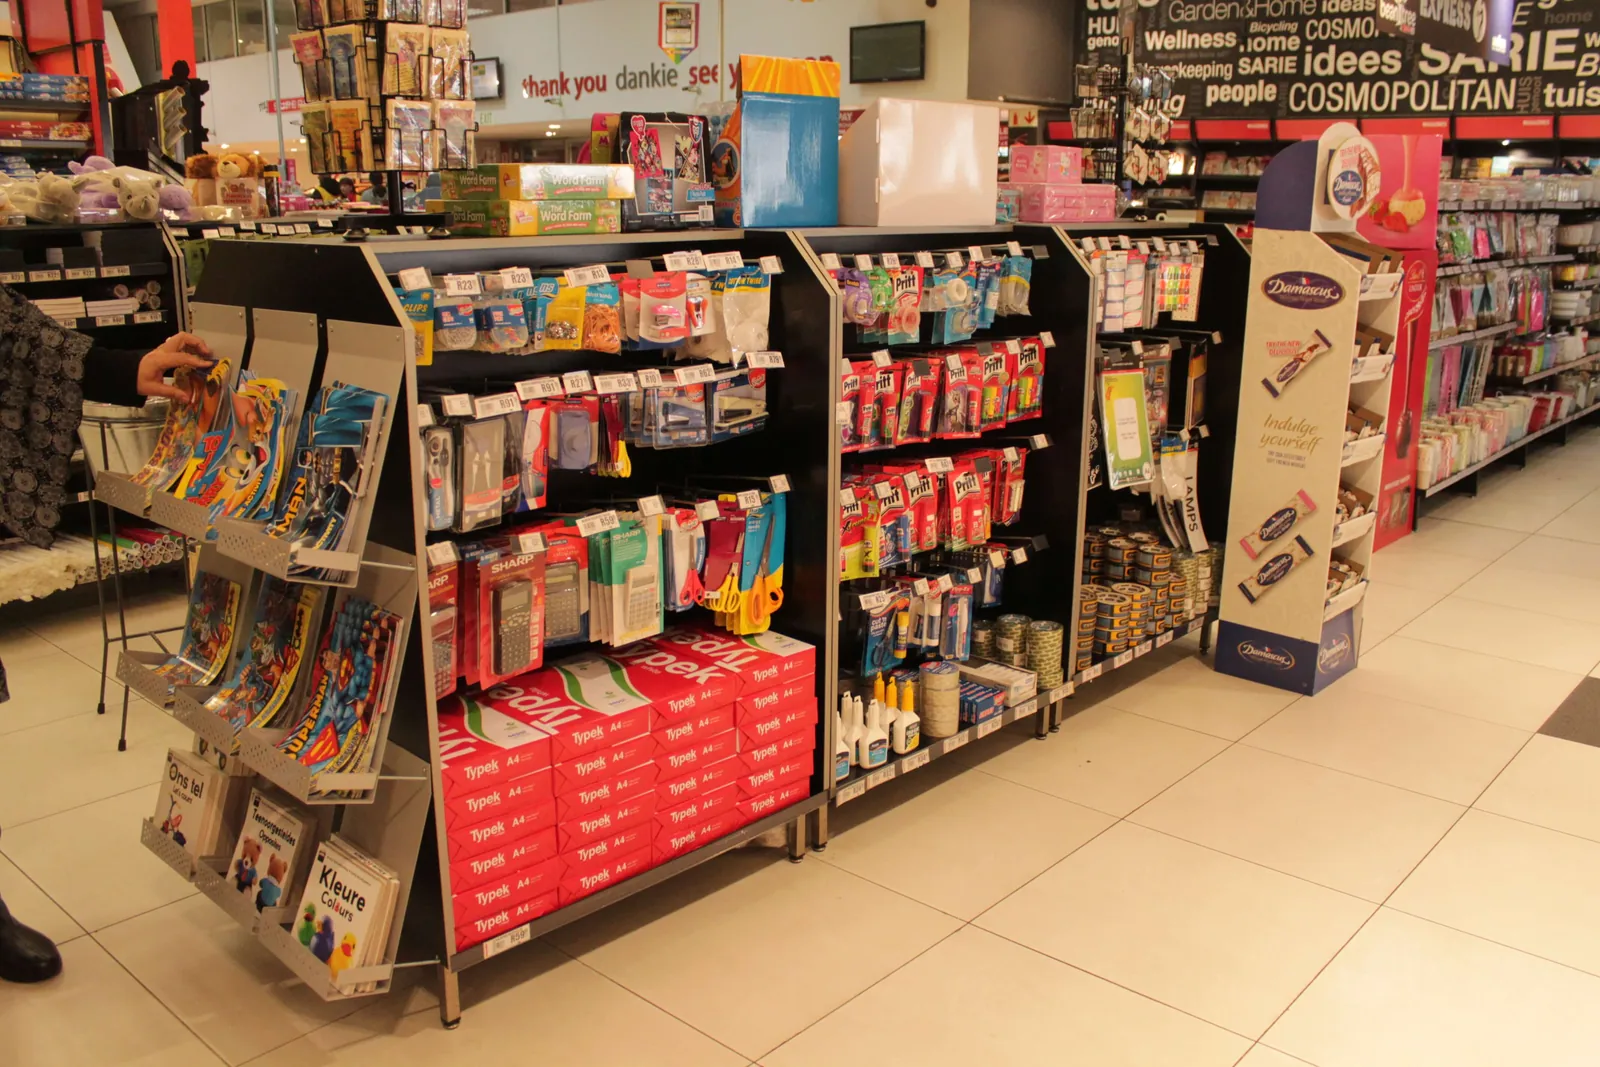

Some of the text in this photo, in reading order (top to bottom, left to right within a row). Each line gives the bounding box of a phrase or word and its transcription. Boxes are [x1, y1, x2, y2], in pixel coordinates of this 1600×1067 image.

[1250, 21, 1298, 34] Bicycling
[1305, 17, 1378, 40] COSMO
[1145, 29, 1237, 50] Wellness
[1238, 55, 1298, 75] SARIE
[1304, 44, 1402, 76] idees
[522, 71, 570, 97] thank
[574, 74, 607, 100] you
[615, 63, 678, 90] dankie
[1205, 79, 1277, 107] people
[1289, 78, 1516, 112] COSMOPOLITAN
[459, 173, 497, 185] Word Farm
[452, 211, 465, 221] ord
[541, 210, 592, 222] Word Farm
[896, 274, 916, 292] Pritt
[1267, 276, 1340, 300] Damascus
[403, 303, 428, 313] CLIPS
[984, 358, 1003, 374] Pritt
[1019, 349, 1037, 365] Pritt
[843, 378, 858, 391] Pritt
[875, 375, 892, 390] ritt
[950, 367, 965, 380] Pritt
[1263, 413, 1318, 438] Indulge
[1258, 433, 1324, 456] yourself
[956, 475, 976, 492] Pritt
[883, 489, 900, 507] ritt
[491, 554, 534, 574] SHARP
[428, 574, 449, 590] ARP
[1243, 643, 1291, 666] Damascus
[753, 662, 793, 682] Typek A4
[668, 690, 711, 713] Typek A4
[753, 688, 793, 710] Typek A4
[572, 721, 622, 746] Typek A4
[666, 718, 709, 741] Typek A4
[755, 713, 796, 735] Typek A4
[669, 745, 713, 768] Typek A4
[752, 739, 793, 761] Typek A4
[464, 754, 520, 780] Typek A4
[575, 751, 624, 777] Typek A4
[169, 763, 204, 799] Ons tel
[669, 772, 713, 796] Typek A4
[748, 765, 790, 787] Typek A4
[466, 787, 522, 812] Typek A4
[578, 780, 628, 804] Typek A4
[751, 790, 789, 813] Typek A4
[580, 809, 629, 834] Typek A4
[670, 799, 713, 823] Typek A4
[470, 815, 525, 843] Typek A4
[670, 825, 711, 849] Typek A4
[578, 836, 625, 861] Typek A4
[471, 847, 526, 874] Typek A4
[580, 863, 627, 889] Typek A4
[318, 865, 366, 914] Kleure
[475, 877, 530, 905] Typek A4
[321, 890, 354, 923] Colours
[475, 904, 529, 933] Typek A4
